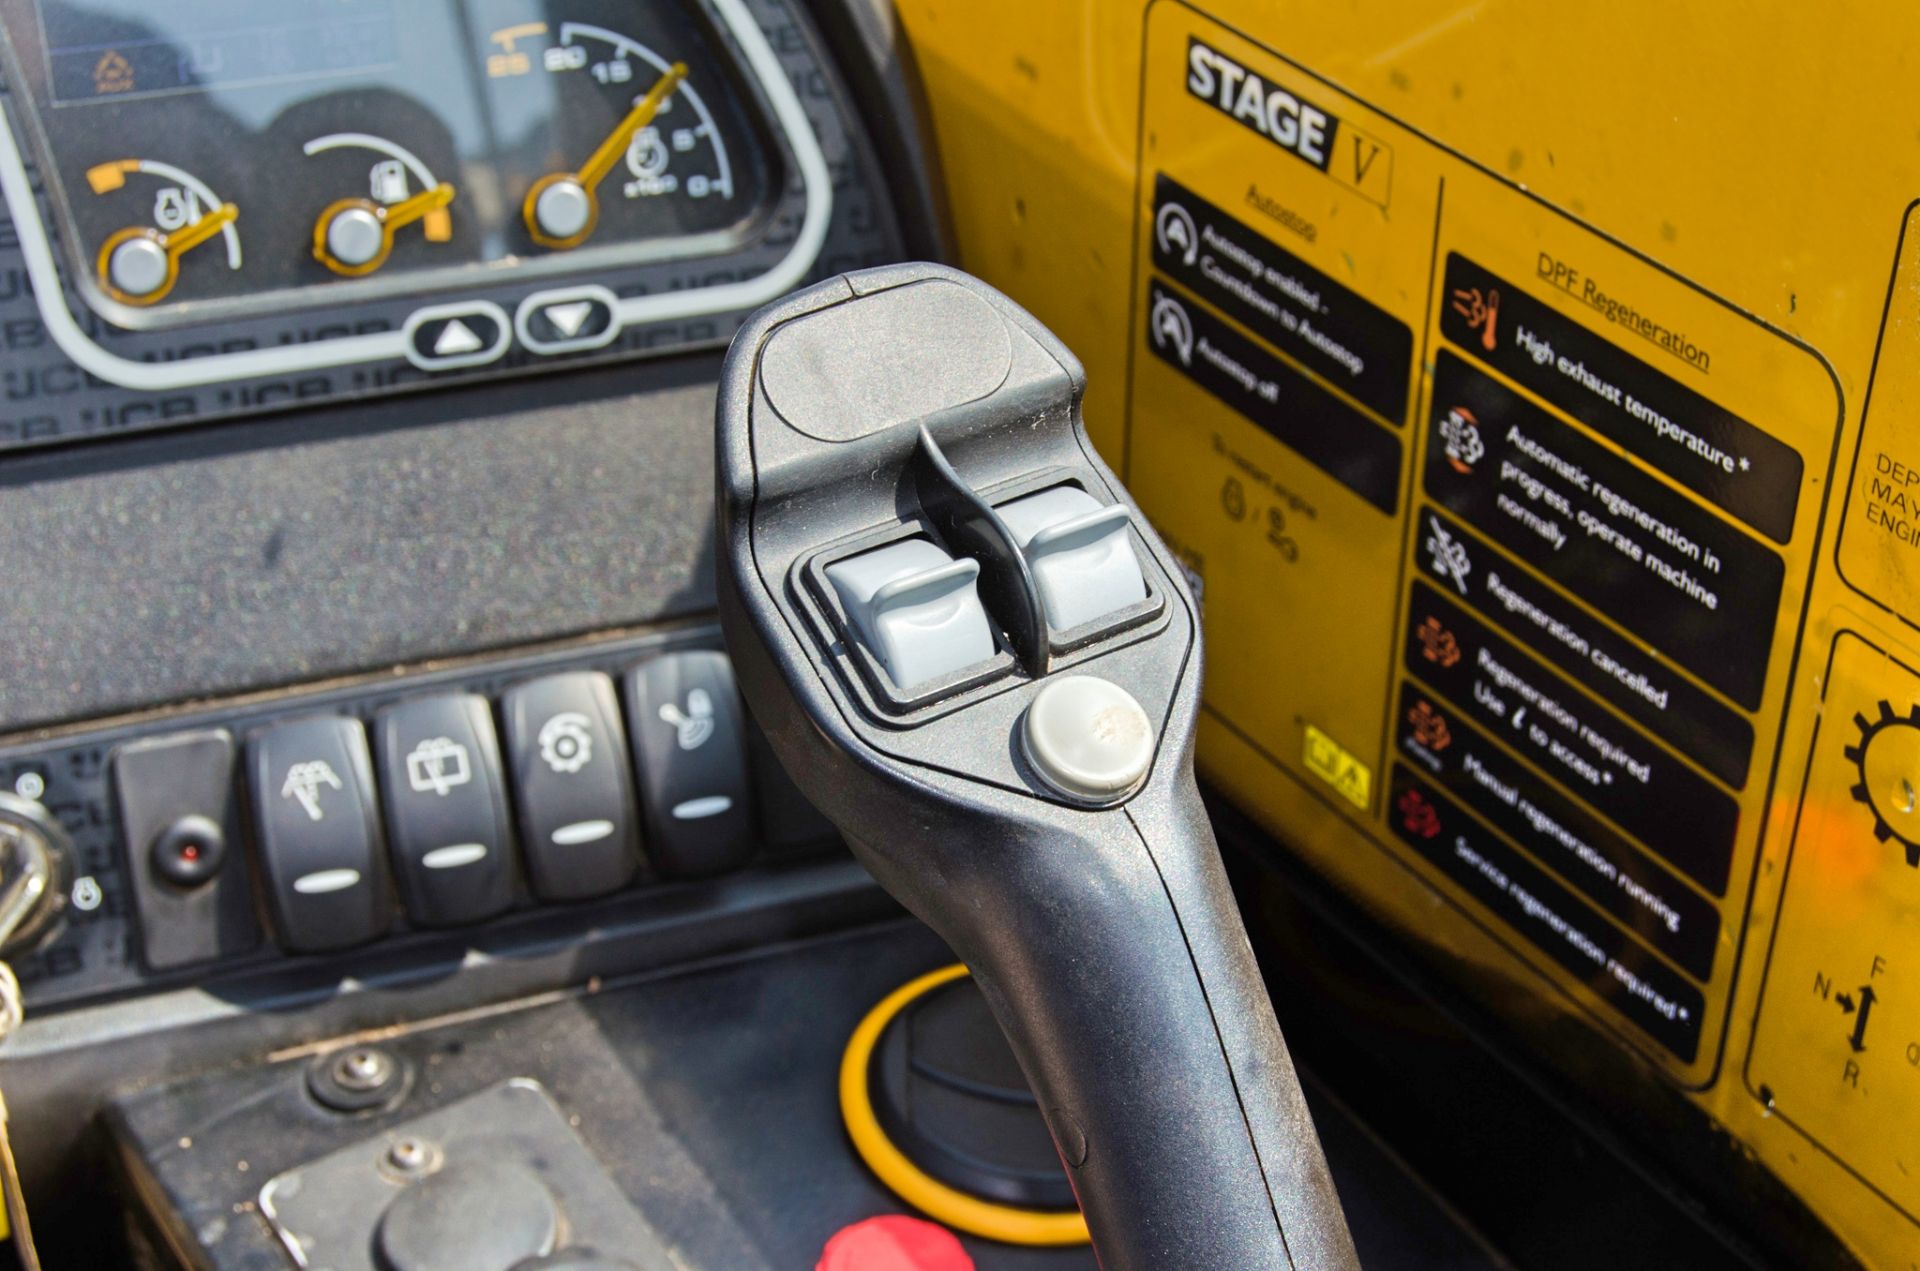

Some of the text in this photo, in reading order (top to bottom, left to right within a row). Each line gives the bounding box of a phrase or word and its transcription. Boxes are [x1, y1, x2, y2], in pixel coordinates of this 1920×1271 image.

[1189, 44, 1381, 186] STAGE V
[1200, 255, 1364, 376] Countdown to Autostop
[1202, 224, 1264, 278] Autostop
[1264, 267, 1320, 311] enabled
[1537, 252, 1711, 369] DPF Regeneration
[1515, 325, 1556, 366] High
[1557, 354, 1622, 405] exhaust
[1497, 493, 1567, 551] normally
[1501, 460, 1718, 610] progress, operate machine
[1506, 425, 1721, 575] Automatic regeneration in
[1487, 571, 1669, 710] Regeneration cancelled
[1473, 680, 1506, 717] Use
[1528, 723, 1549, 748] to
[1477, 647, 1652, 784] Regeneration required
[1455, 836, 1509, 891] Service
[1509, 882, 1607, 966] regeneration
[1463, 752, 1681, 933] Manual regeneration running
[1813, 970, 1832, 1001] N
[1870, 955, 1887, 980] F
[1843, 1058, 1861, 1090] R
